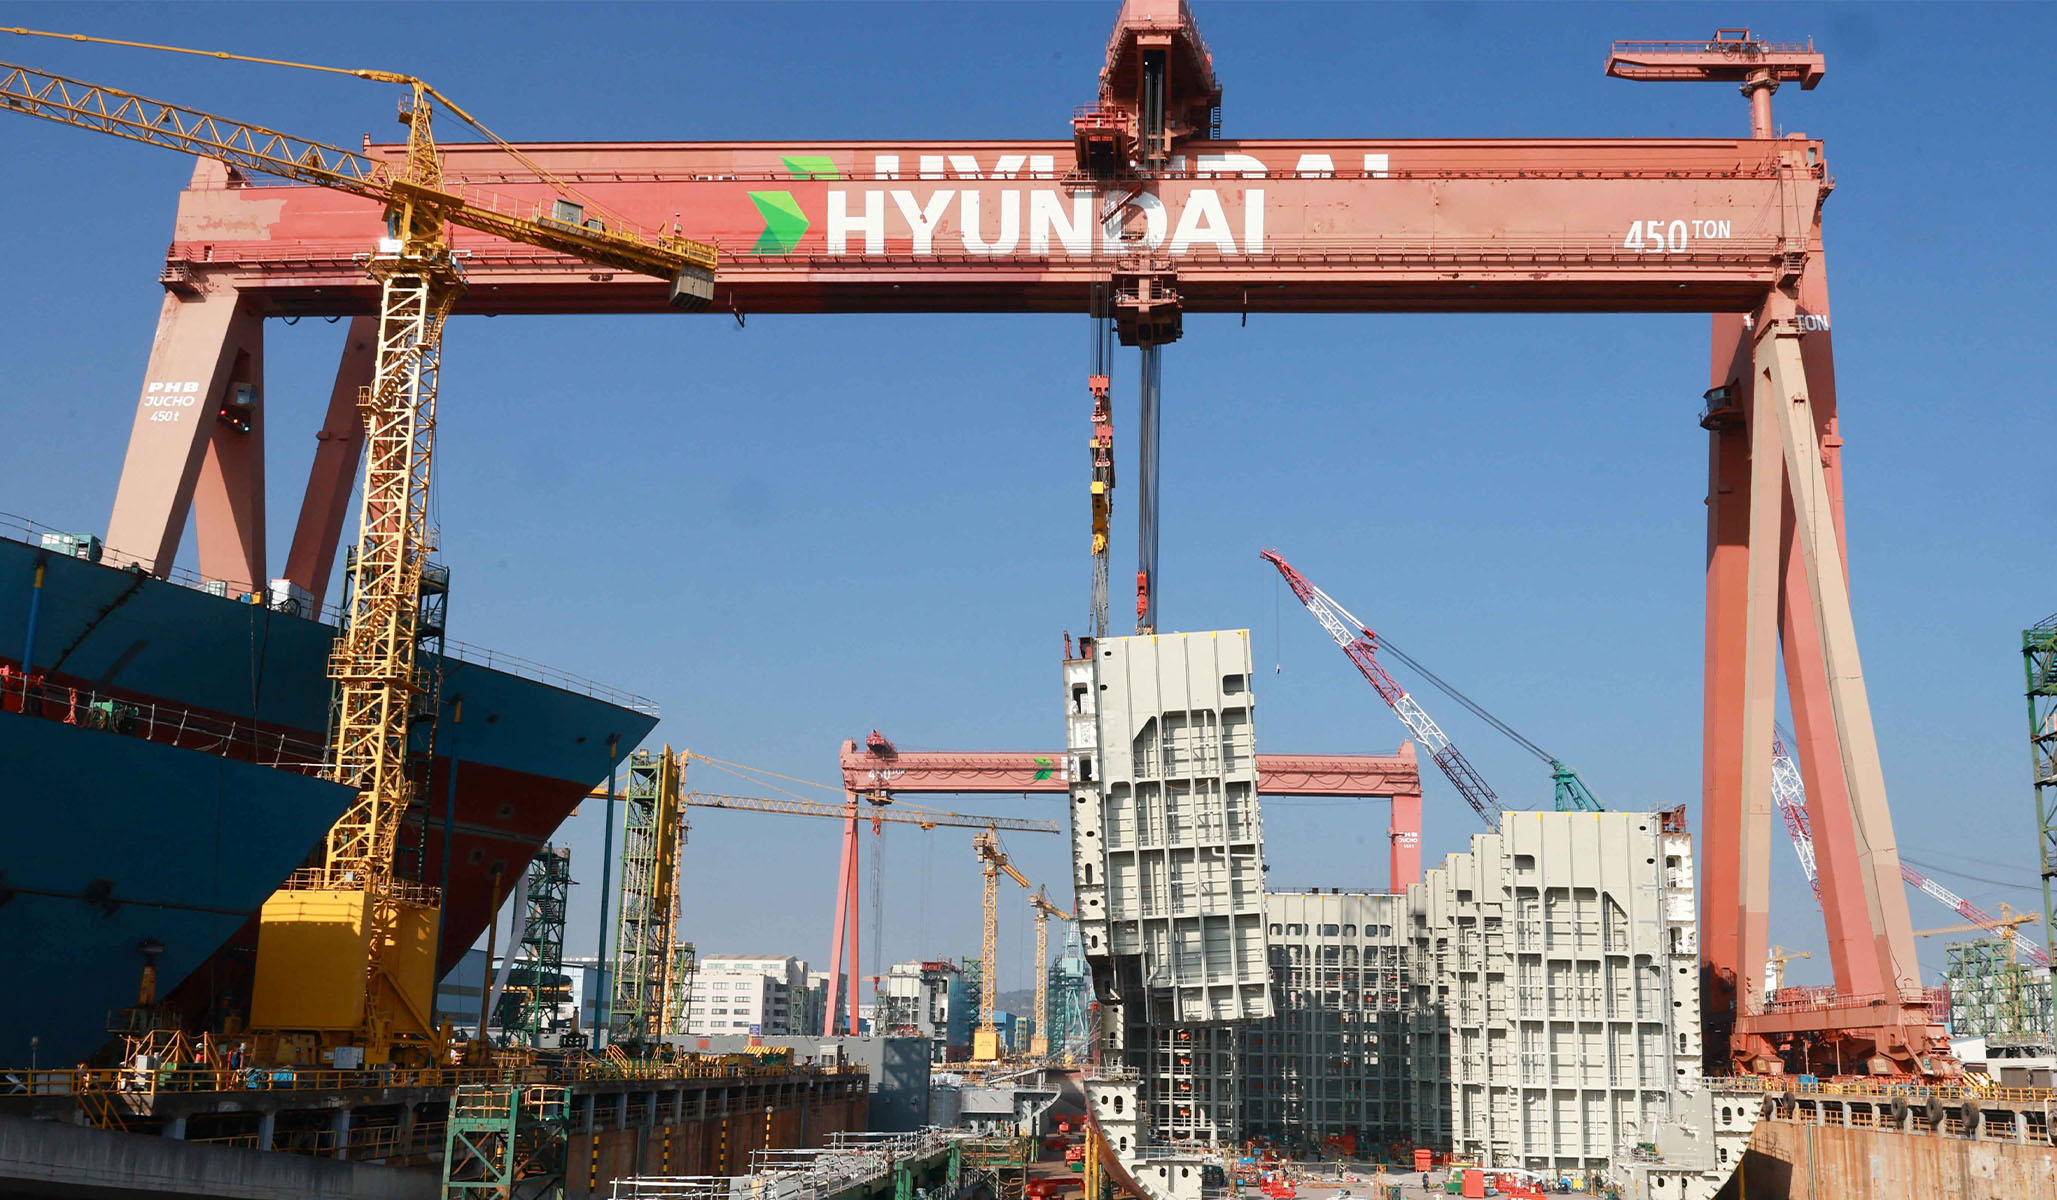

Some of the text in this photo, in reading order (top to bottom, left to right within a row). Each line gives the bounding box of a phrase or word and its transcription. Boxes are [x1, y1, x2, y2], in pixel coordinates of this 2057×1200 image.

[827, 189, 1265, 255] HYUNDAI
[1623, 219, 1731, 253] 450 TON
[1795, 314, 1829, 331] TON
[148, 381, 200, 393] PHB
[144, 395, 196, 407] JUCHO
